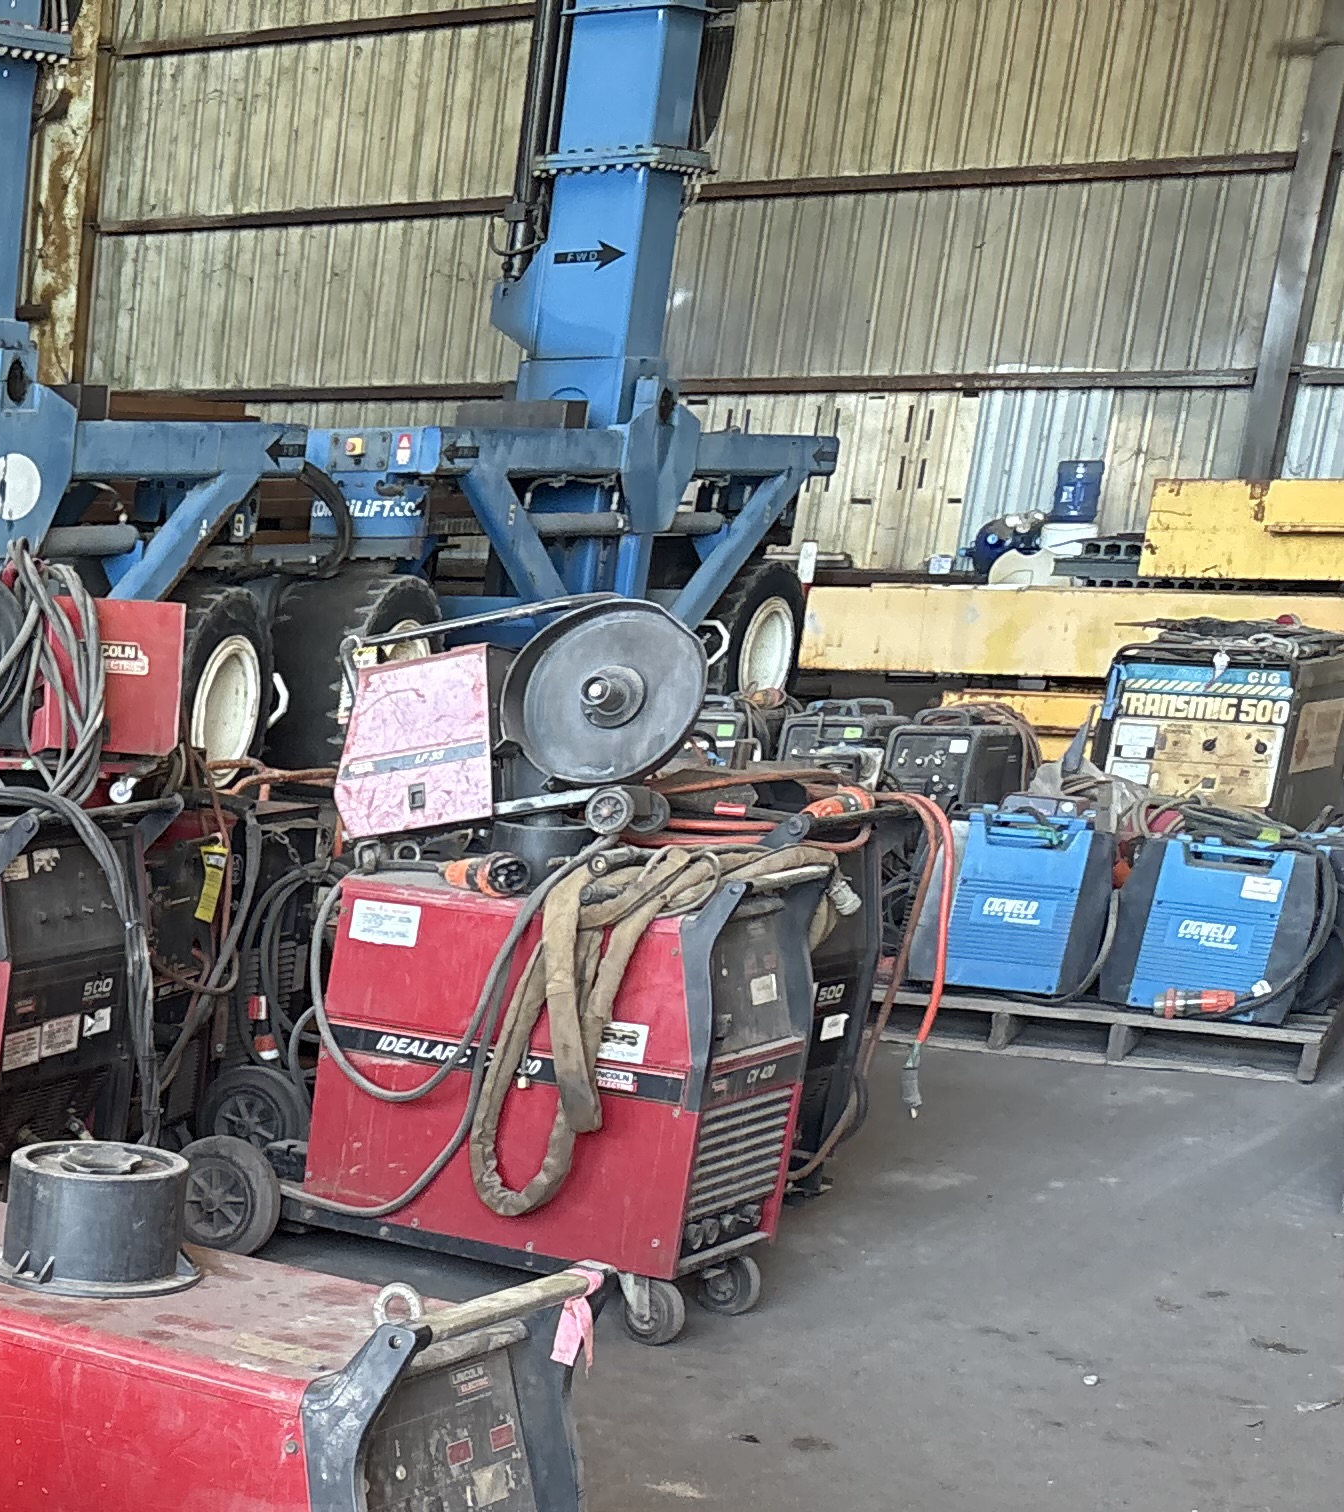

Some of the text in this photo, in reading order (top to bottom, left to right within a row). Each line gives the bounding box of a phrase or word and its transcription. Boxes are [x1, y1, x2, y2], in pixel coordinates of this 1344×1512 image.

[566, 251, 598, 262] FWD
[101, 644, 136, 659] COLN
[1247, 671, 1281, 684] CIG
[1238, 699, 1291, 725] 500
[817, 983, 846, 1002] 500
